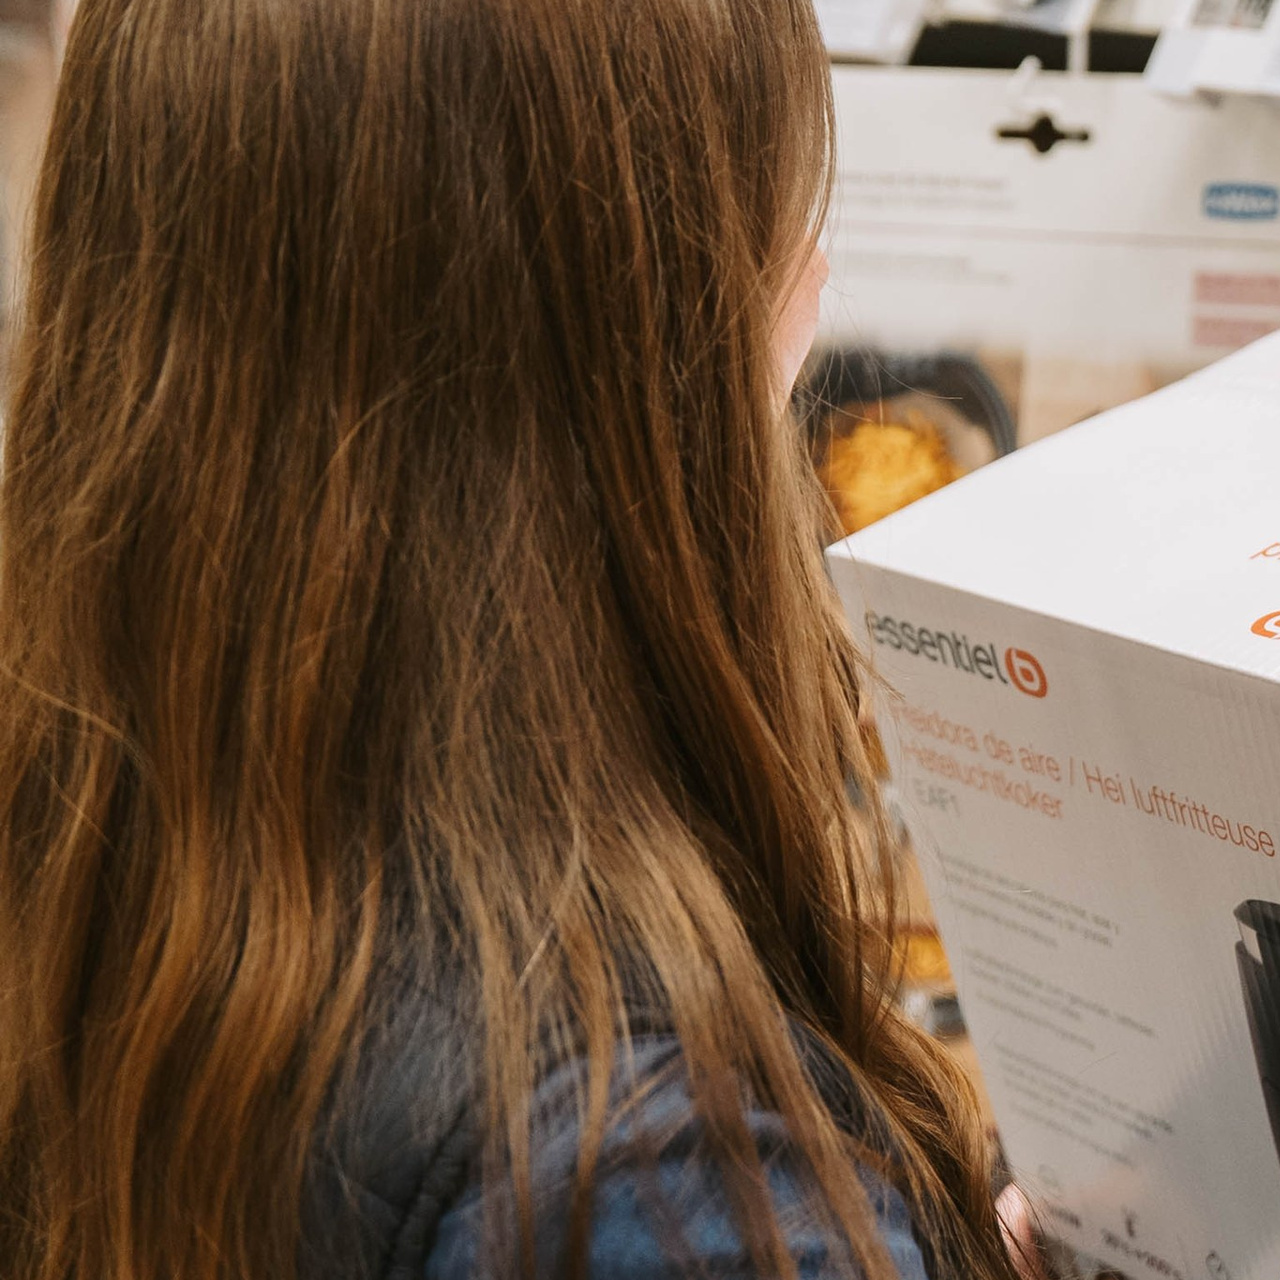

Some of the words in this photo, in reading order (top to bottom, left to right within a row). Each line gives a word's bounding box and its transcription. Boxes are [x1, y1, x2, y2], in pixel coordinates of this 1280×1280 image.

[1018, 742, 1063, 783] aire
[1081, 760, 1127, 806] Hei
[1129, 775, 1276, 858] luftfritteuse
